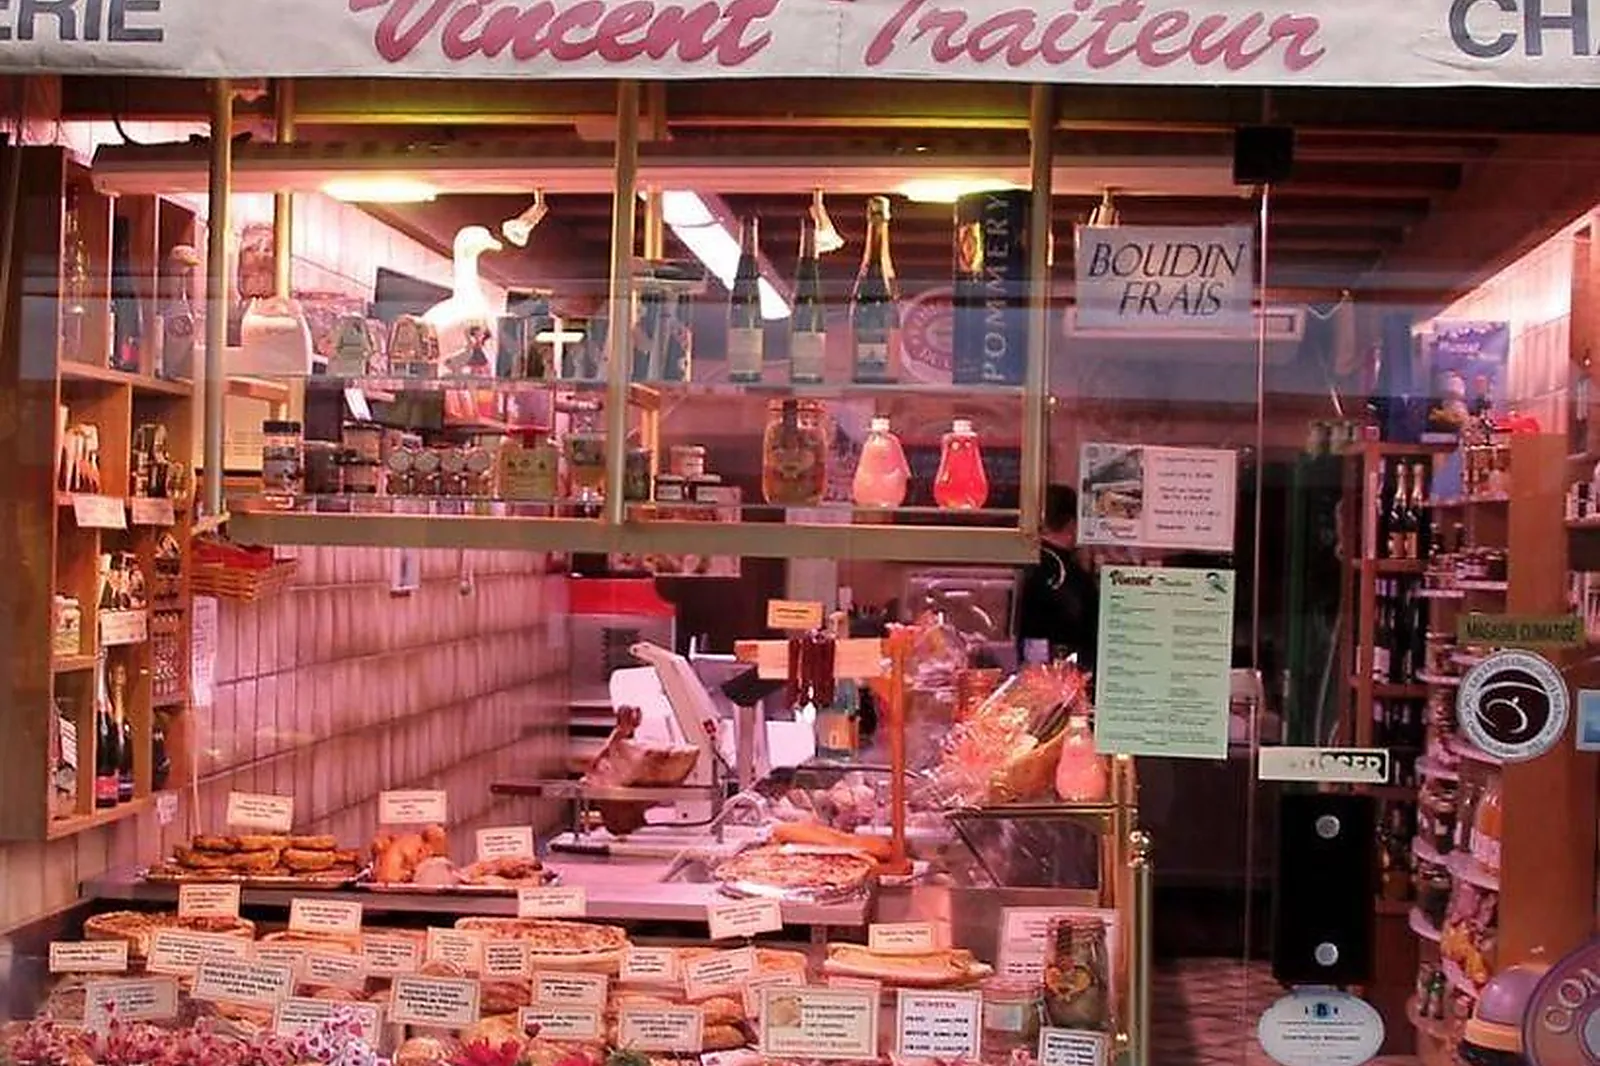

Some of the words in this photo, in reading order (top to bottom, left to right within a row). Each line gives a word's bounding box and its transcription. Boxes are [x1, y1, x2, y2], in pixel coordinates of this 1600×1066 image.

[0, 0, 163, 42] RIE
[348, 0, 778, 66] Vincent
[864, 0, 1326, 72] Traiteur
[1450, 0, 1600, 58] CH
[1087, 242, 1246, 277] BOUDIN
[982, 194, 1010, 382] POMMERY
[1118, 281, 1226, 316] FRAIS
